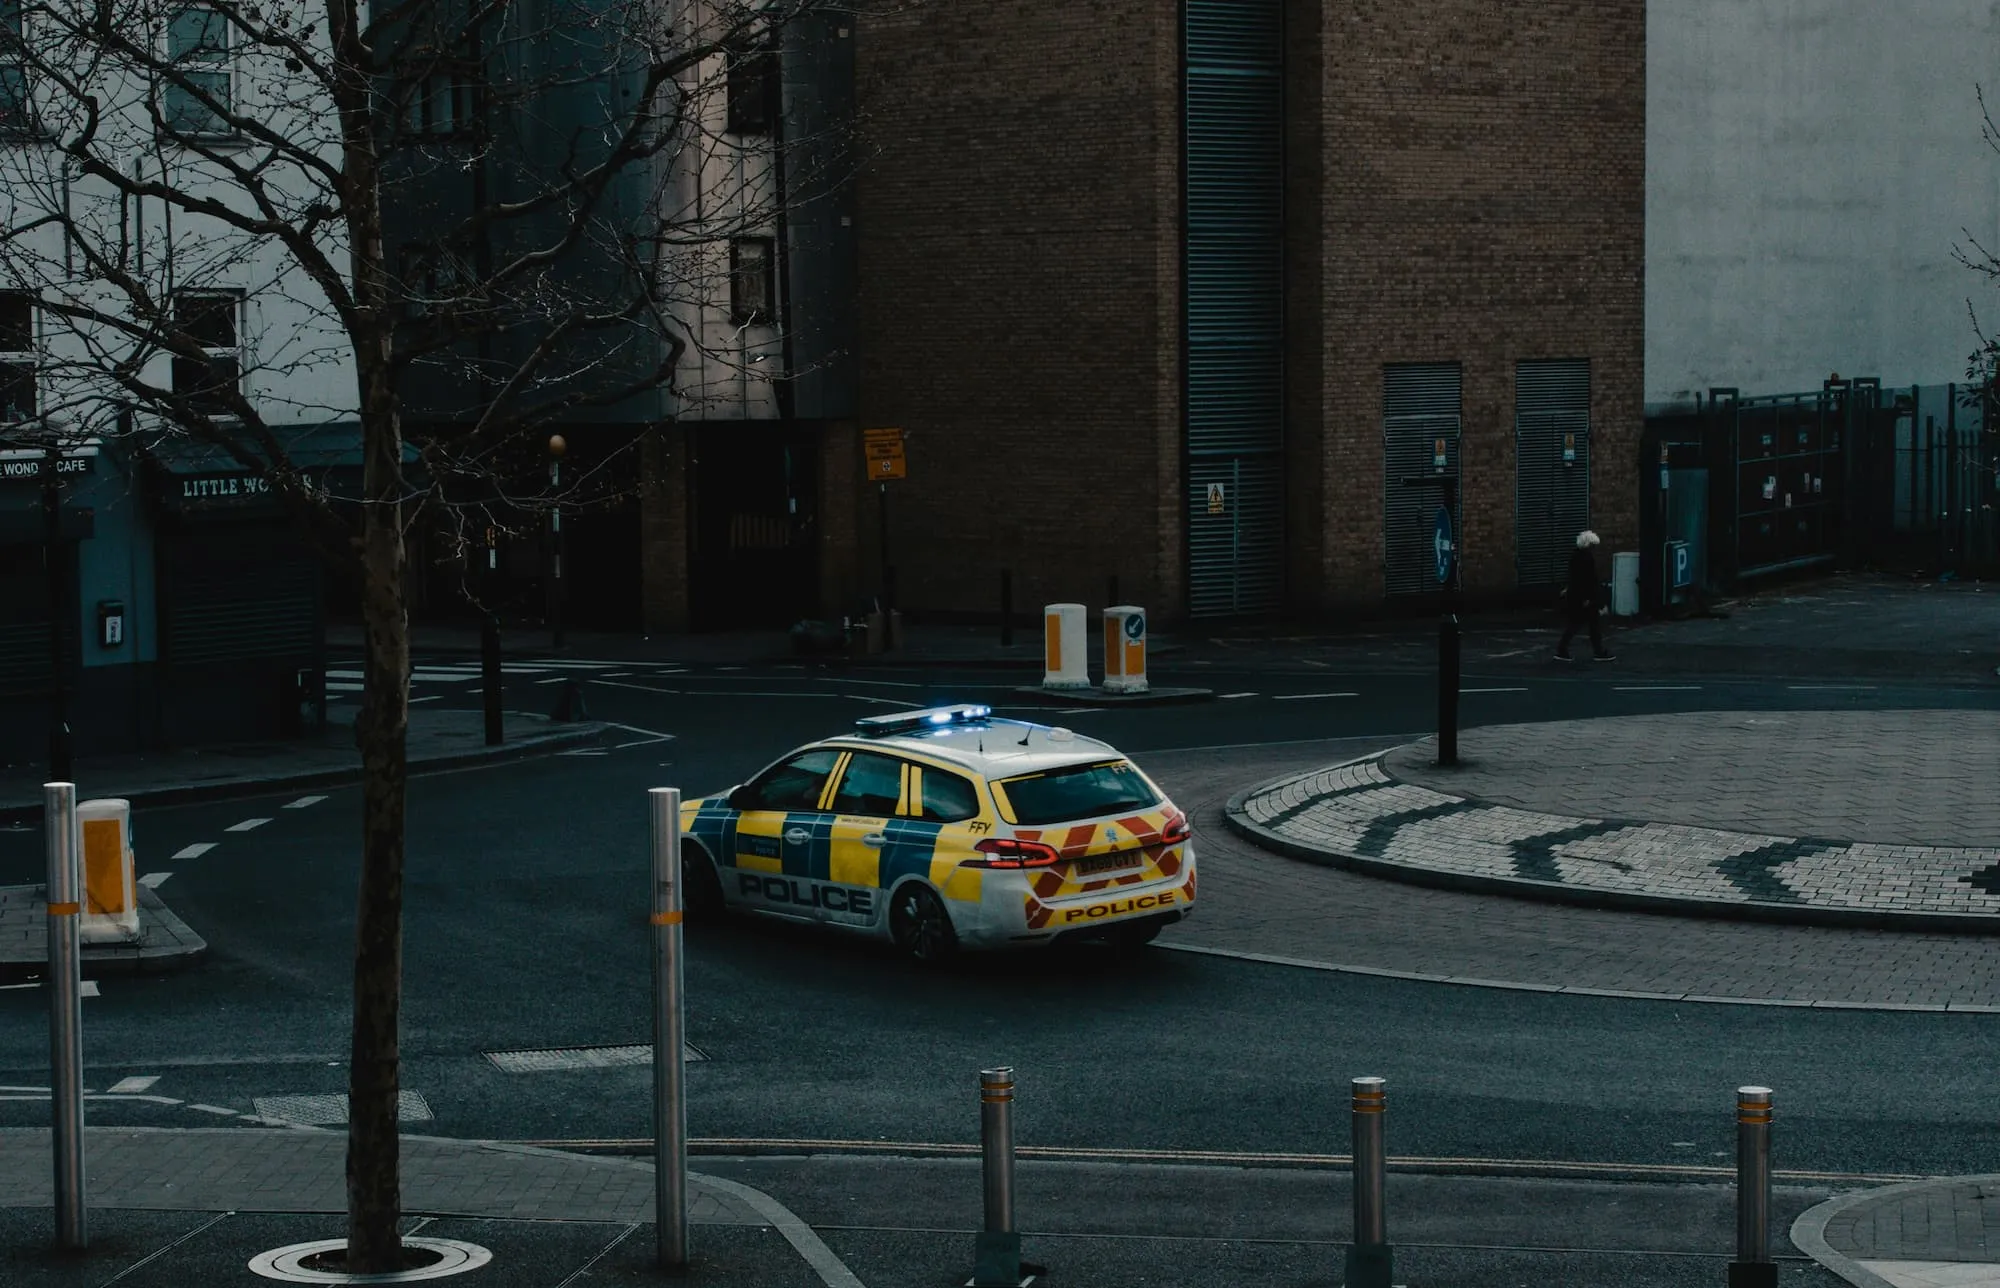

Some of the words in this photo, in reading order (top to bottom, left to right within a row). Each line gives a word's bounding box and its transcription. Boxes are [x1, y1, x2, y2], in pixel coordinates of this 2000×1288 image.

[56, 459, 87, 472] CAFE
[183, 478, 240, 497] LITTLE
[1677, 548, 1687, 583] P
[969, 821, 992, 835] FFY
[738, 873, 873, 914] POLICE
[1066, 892, 1174, 921] POLICE
